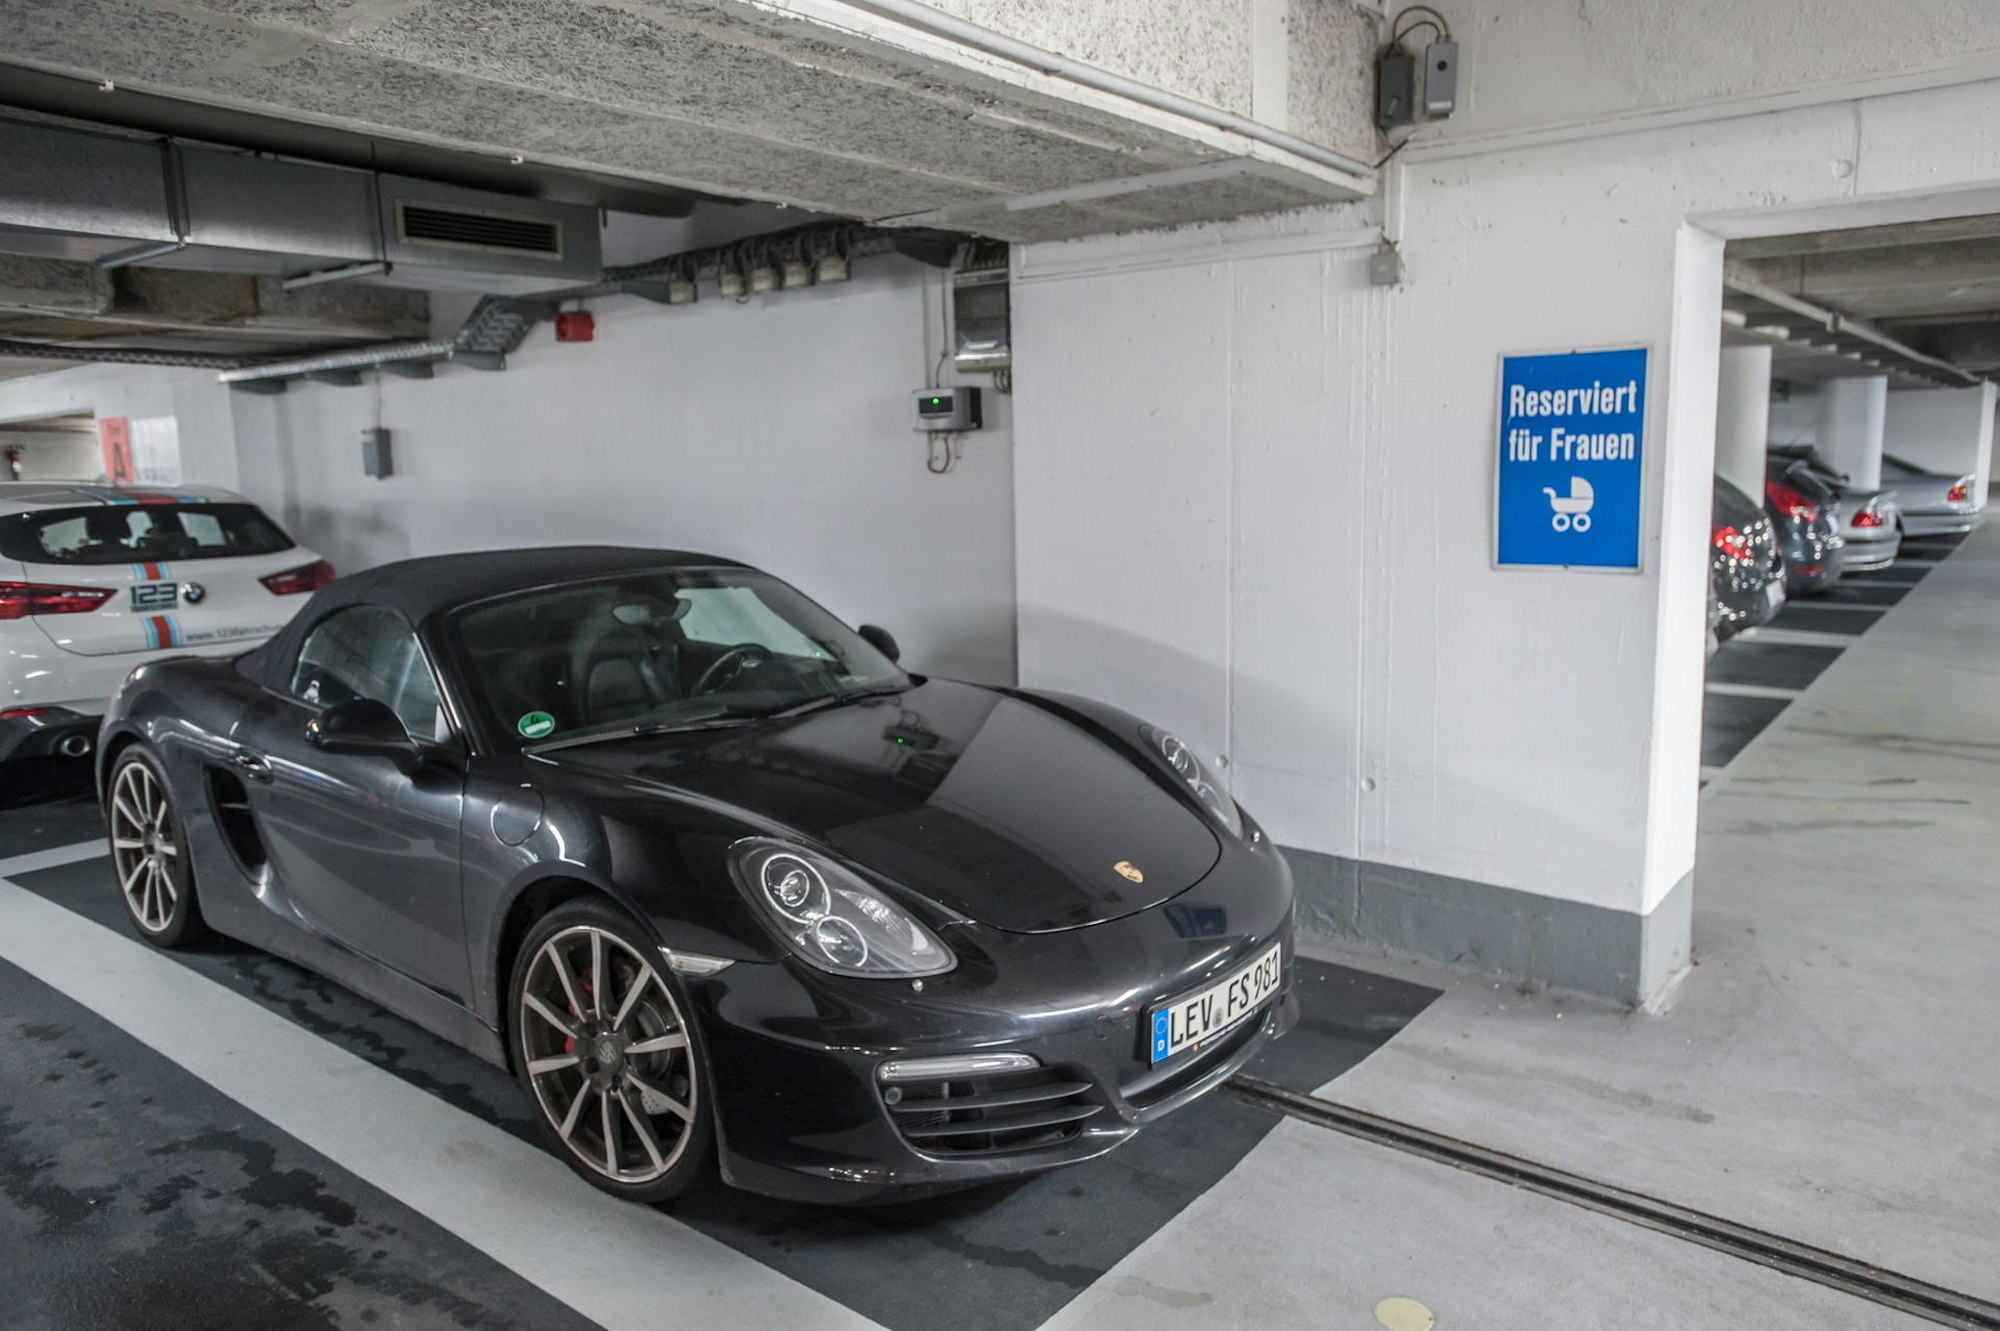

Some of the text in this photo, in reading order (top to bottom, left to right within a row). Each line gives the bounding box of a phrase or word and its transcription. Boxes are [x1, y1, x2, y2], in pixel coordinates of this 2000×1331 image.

[1510, 380, 1637, 418] Reserviert
[1508, 427, 1635, 462] für Frauen
[130, 582, 178, 605] 123
[1158, 1039, 1164, 1052] D
[1170, 994, 1213, 1048] LEV
[1227, 973, 1250, 1018] FS
[1254, 951, 1279, 999] 981
